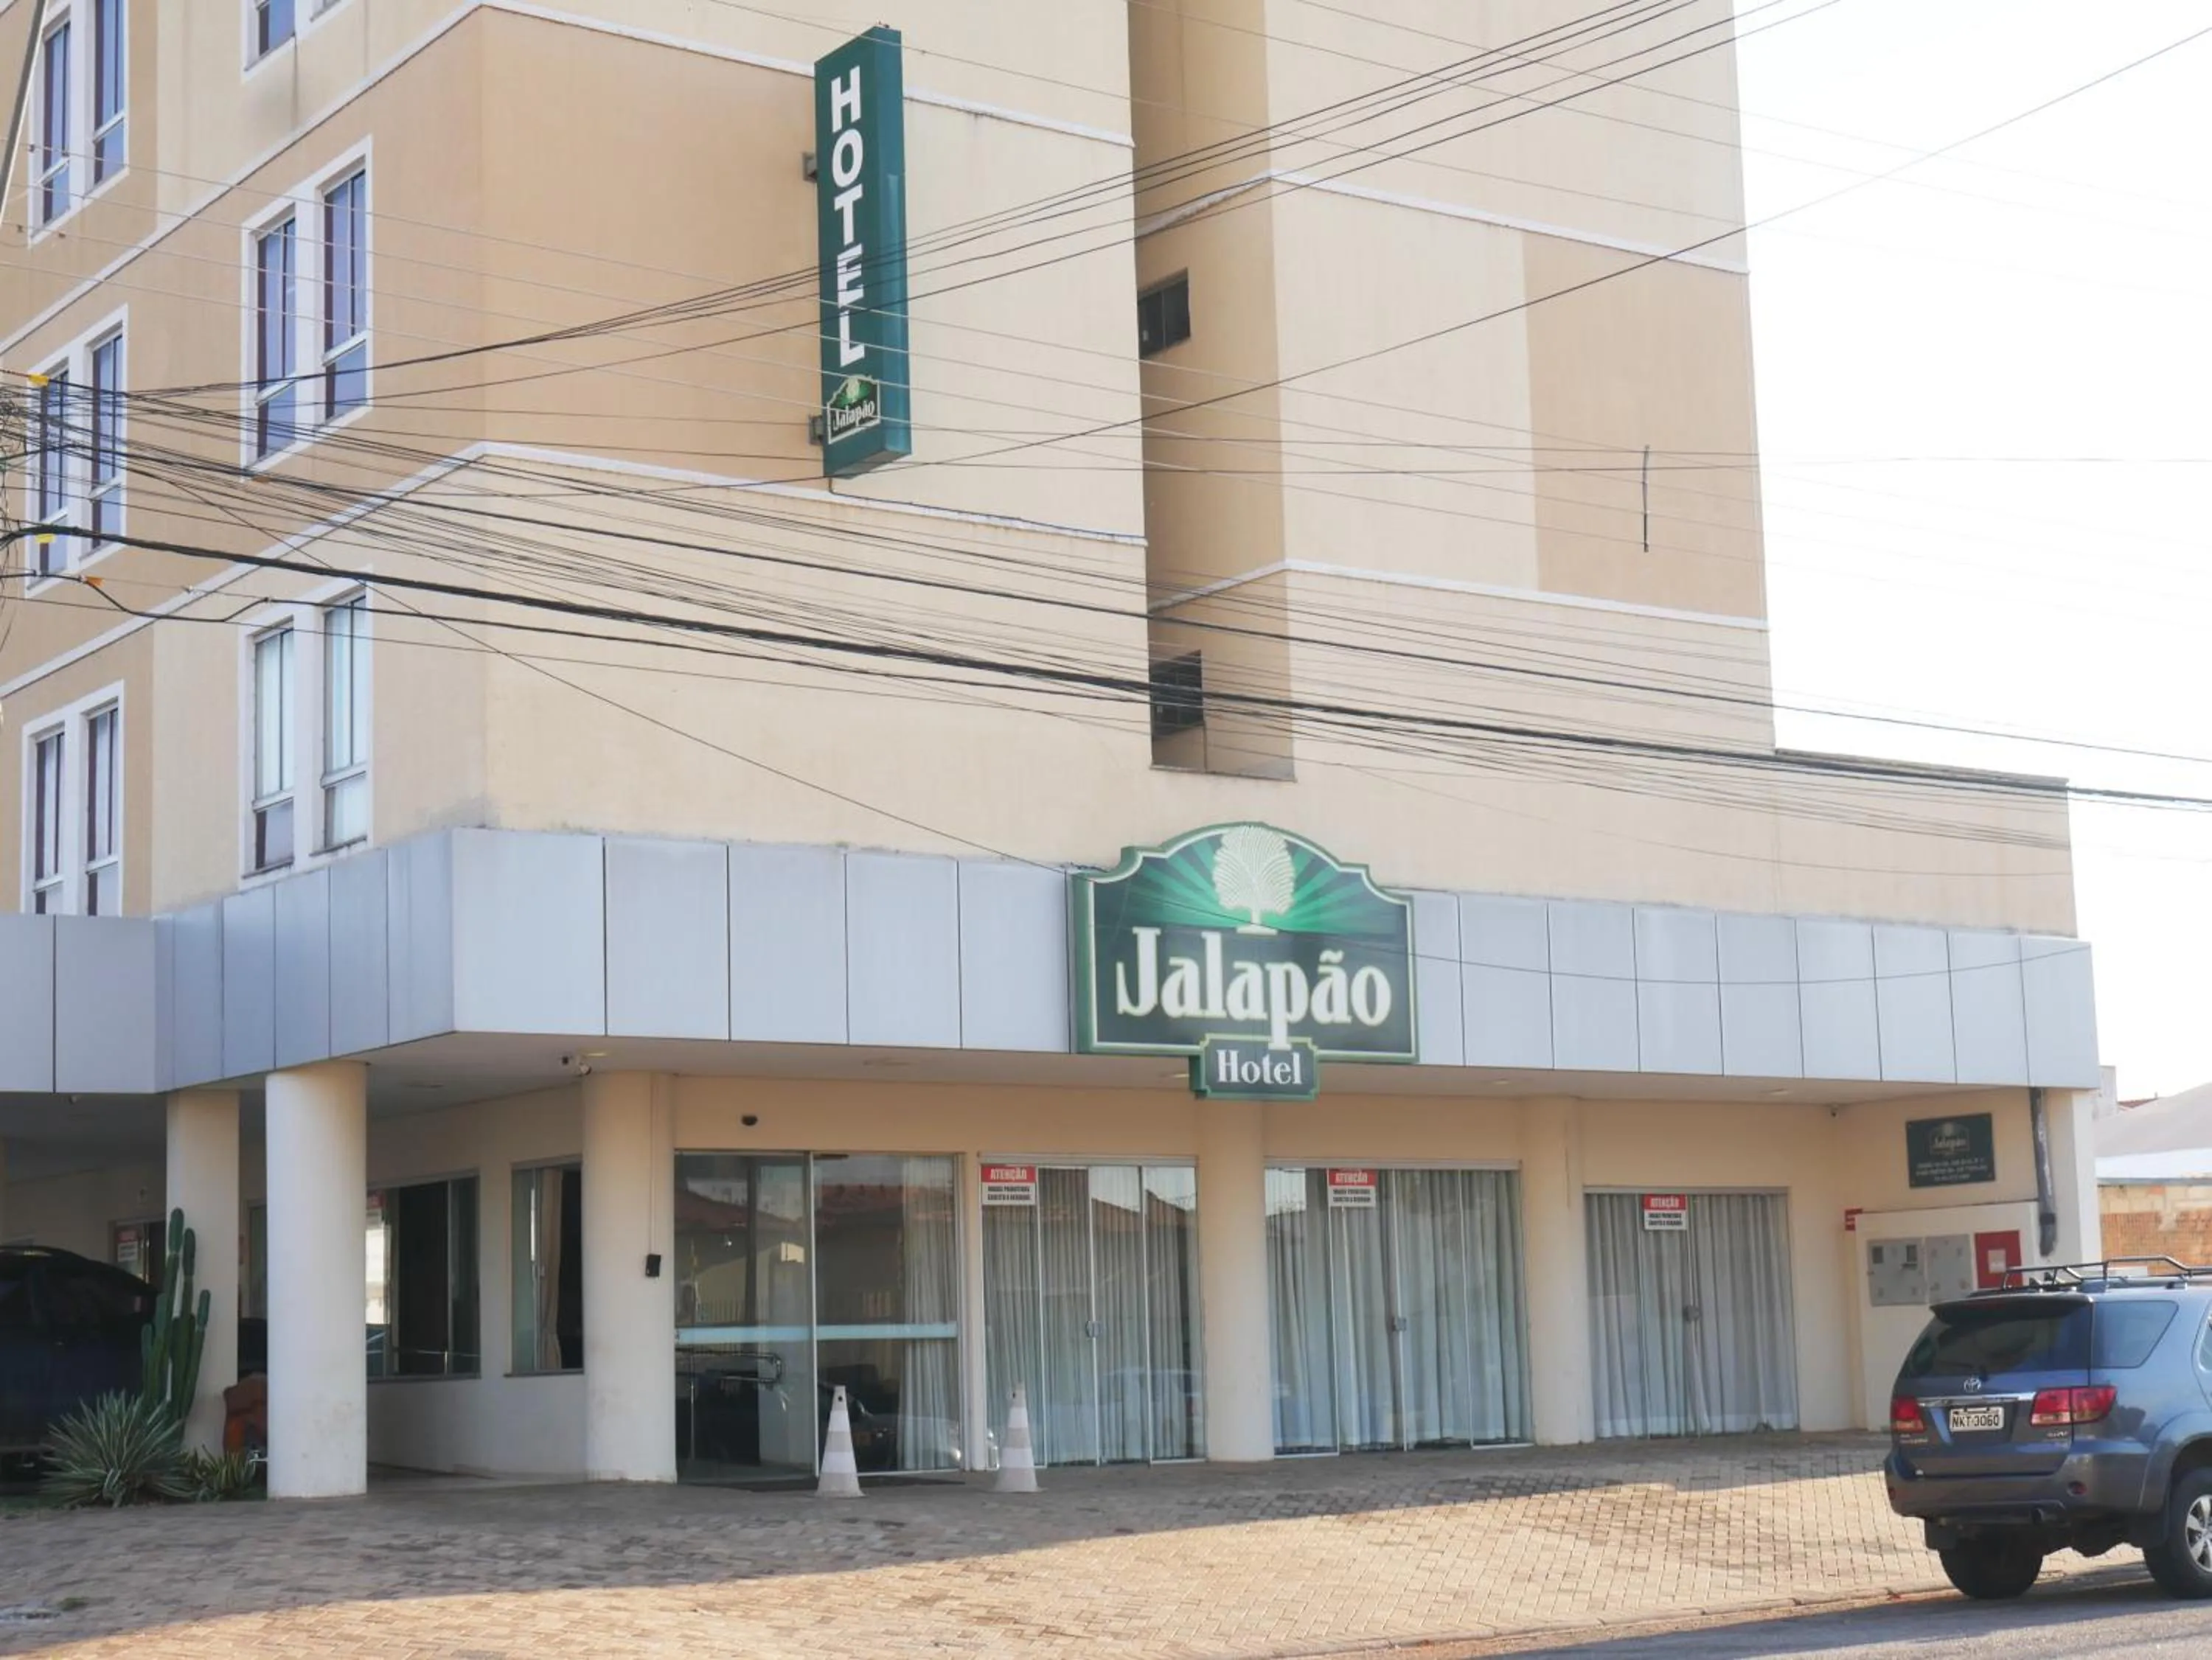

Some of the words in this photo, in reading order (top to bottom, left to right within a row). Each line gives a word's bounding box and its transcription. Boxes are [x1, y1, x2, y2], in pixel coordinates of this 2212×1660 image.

[830, 66, 866, 368] HOTEL
[1116, 927, 1392, 1051] Jalapão
[1216, 1049, 1303, 1086] Hotel
